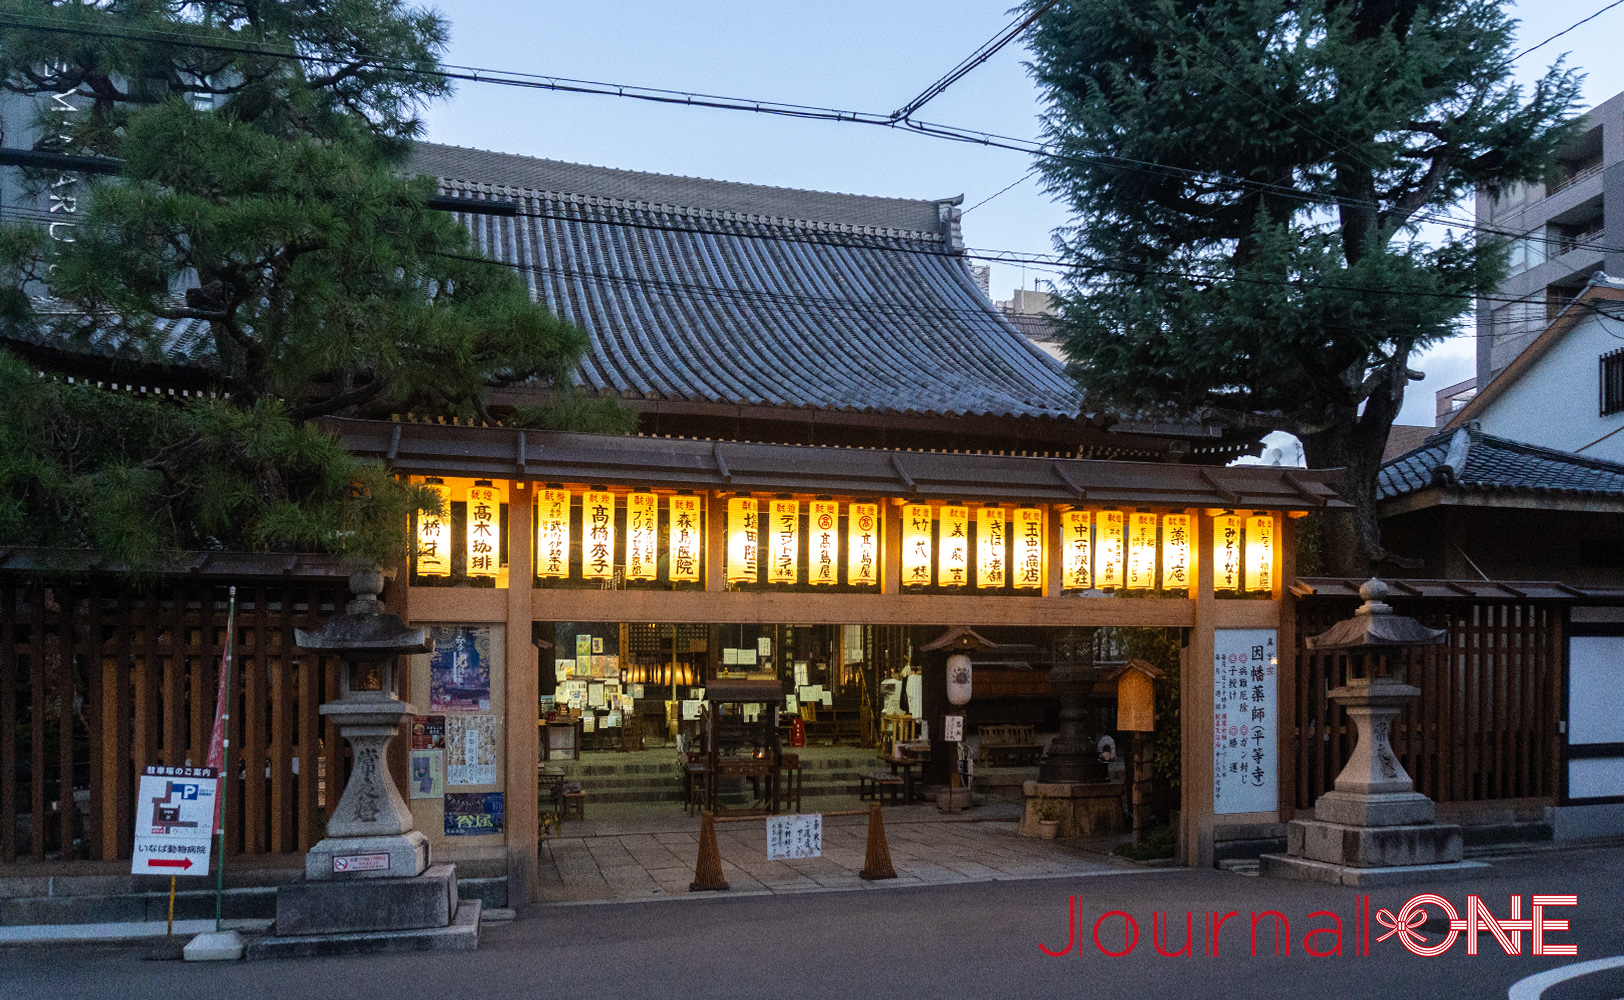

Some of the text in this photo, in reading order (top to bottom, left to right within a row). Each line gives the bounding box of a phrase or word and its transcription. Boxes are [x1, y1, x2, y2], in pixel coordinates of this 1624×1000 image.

[422, 519, 441, 565] 橋才一
[146, 766, 211, 777] 駐車場のご案内
[183, 785, 197, 799] P
[138, 844, 206, 855] いなば動物病院
